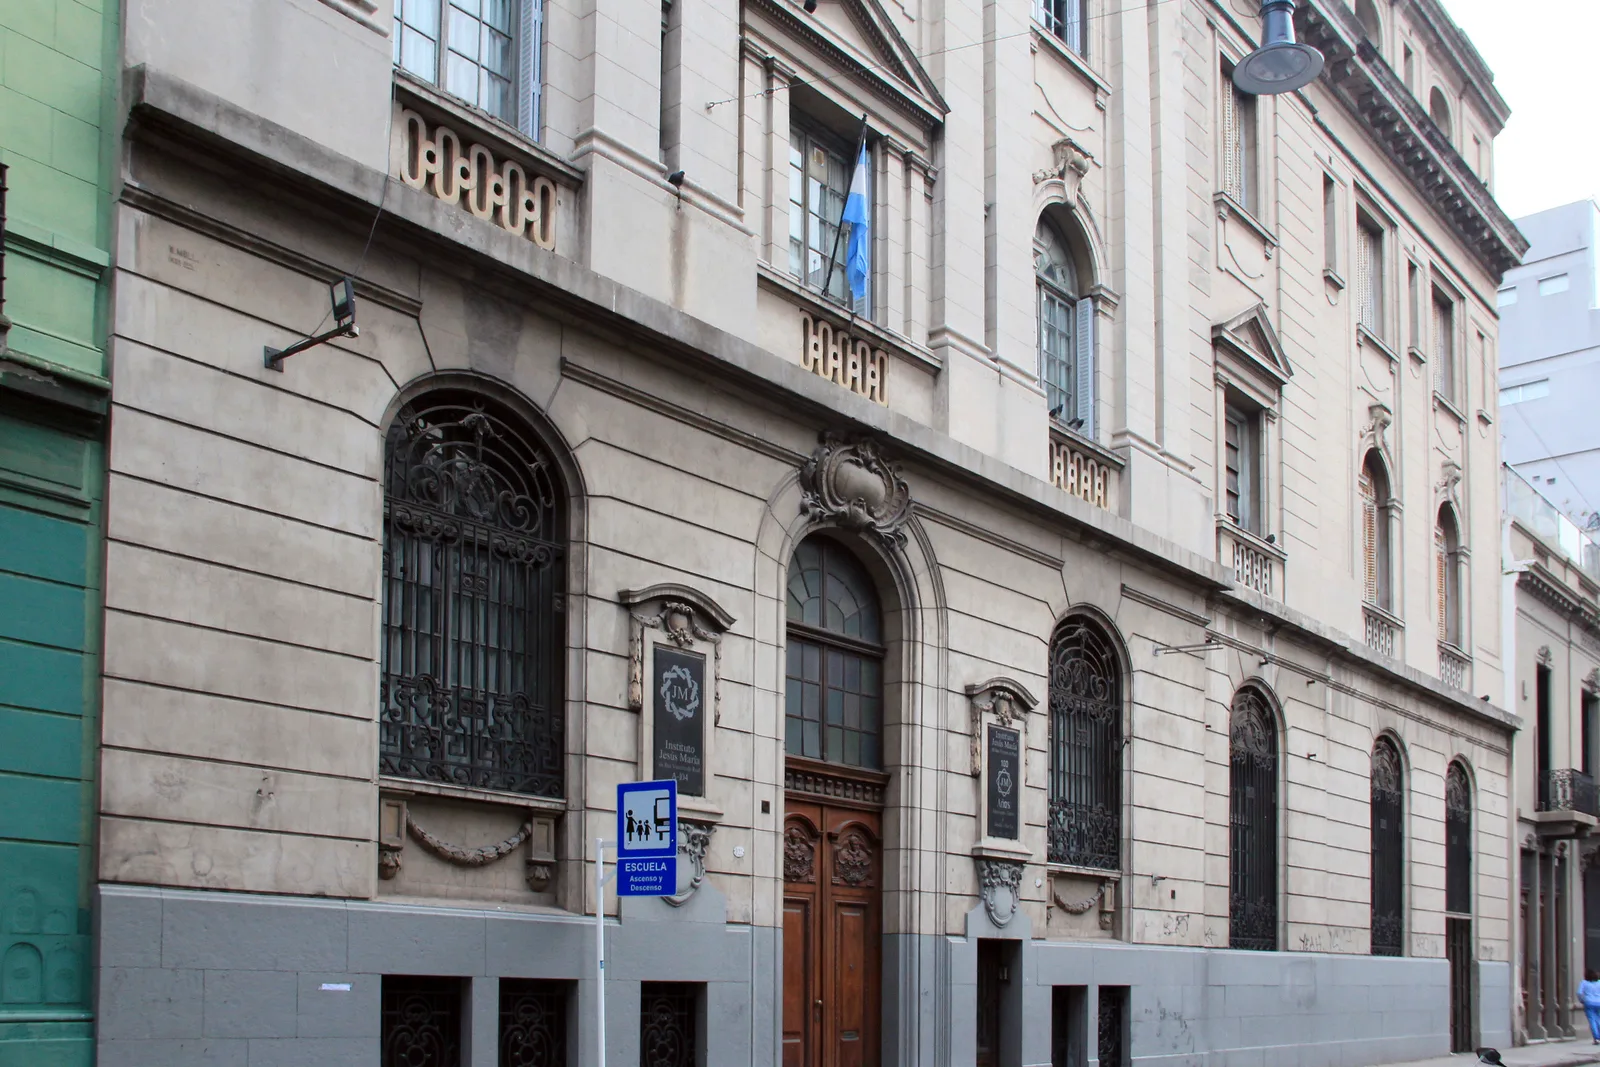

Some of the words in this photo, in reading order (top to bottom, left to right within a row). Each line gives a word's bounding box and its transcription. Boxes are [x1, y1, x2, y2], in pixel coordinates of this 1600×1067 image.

[671, 685, 689, 701] JM
[665, 739, 696, 754] Instituto
[659, 749, 678, 761] Jesús
[679, 752, 700, 765] María
[625, 862, 667, 872] ESCUELA
[630, 884, 663, 892] Descenso
